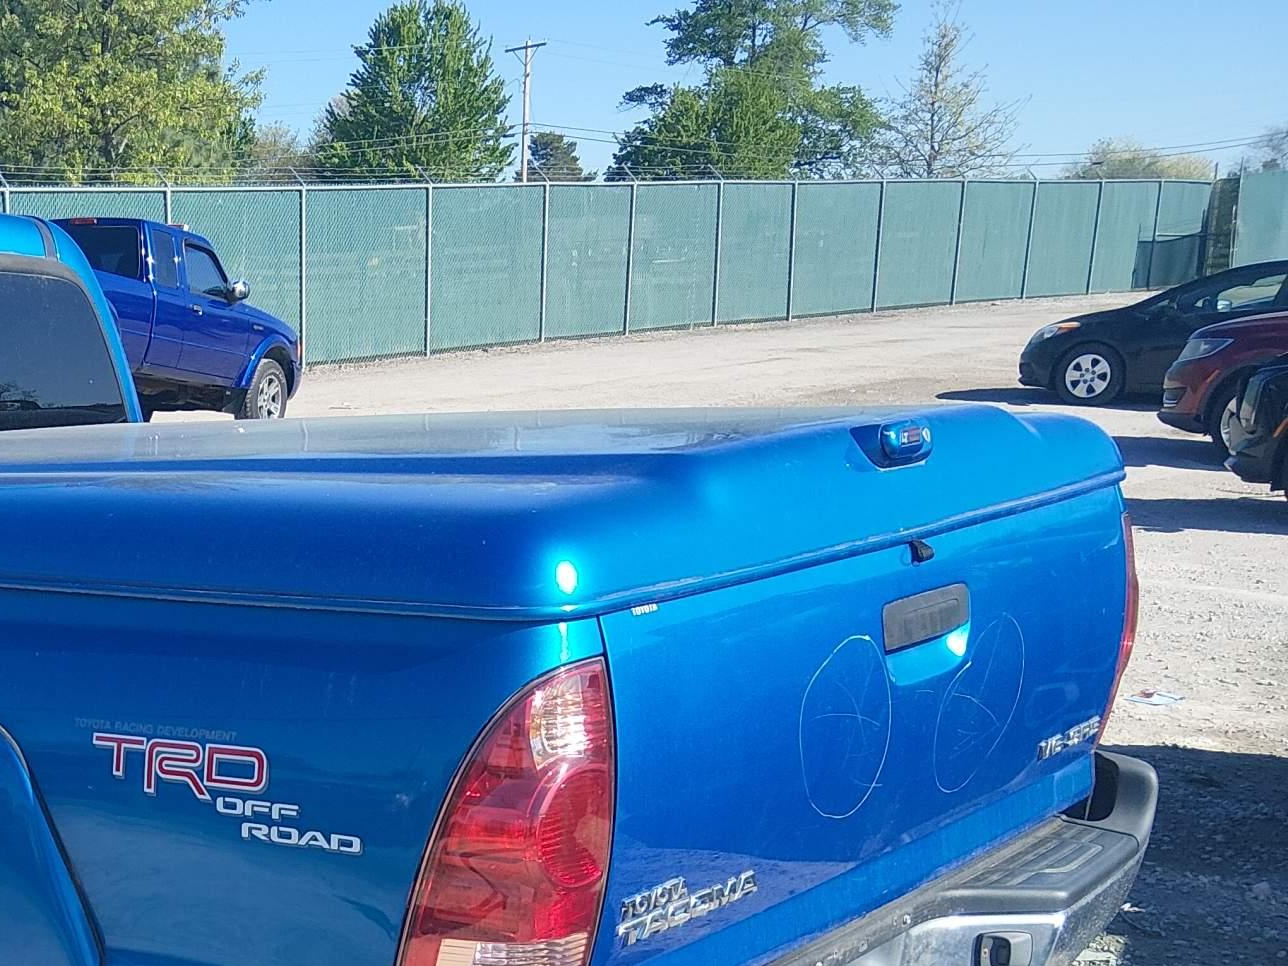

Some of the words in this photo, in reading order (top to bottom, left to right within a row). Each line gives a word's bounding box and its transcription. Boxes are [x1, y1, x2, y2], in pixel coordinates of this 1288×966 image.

[74, 717, 111, 730] TOYOTA
[115, 720, 153, 735] RACING
[157, 725, 237, 742] DEVELOPMENT
[92, 732, 269, 800] TRD
[216, 797, 300, 822] OFF
[241, 822, 363, 855] ROAD
[616, 869, 758, 948] TACOMA
[621, 876, 688, 921] TOYOTA
